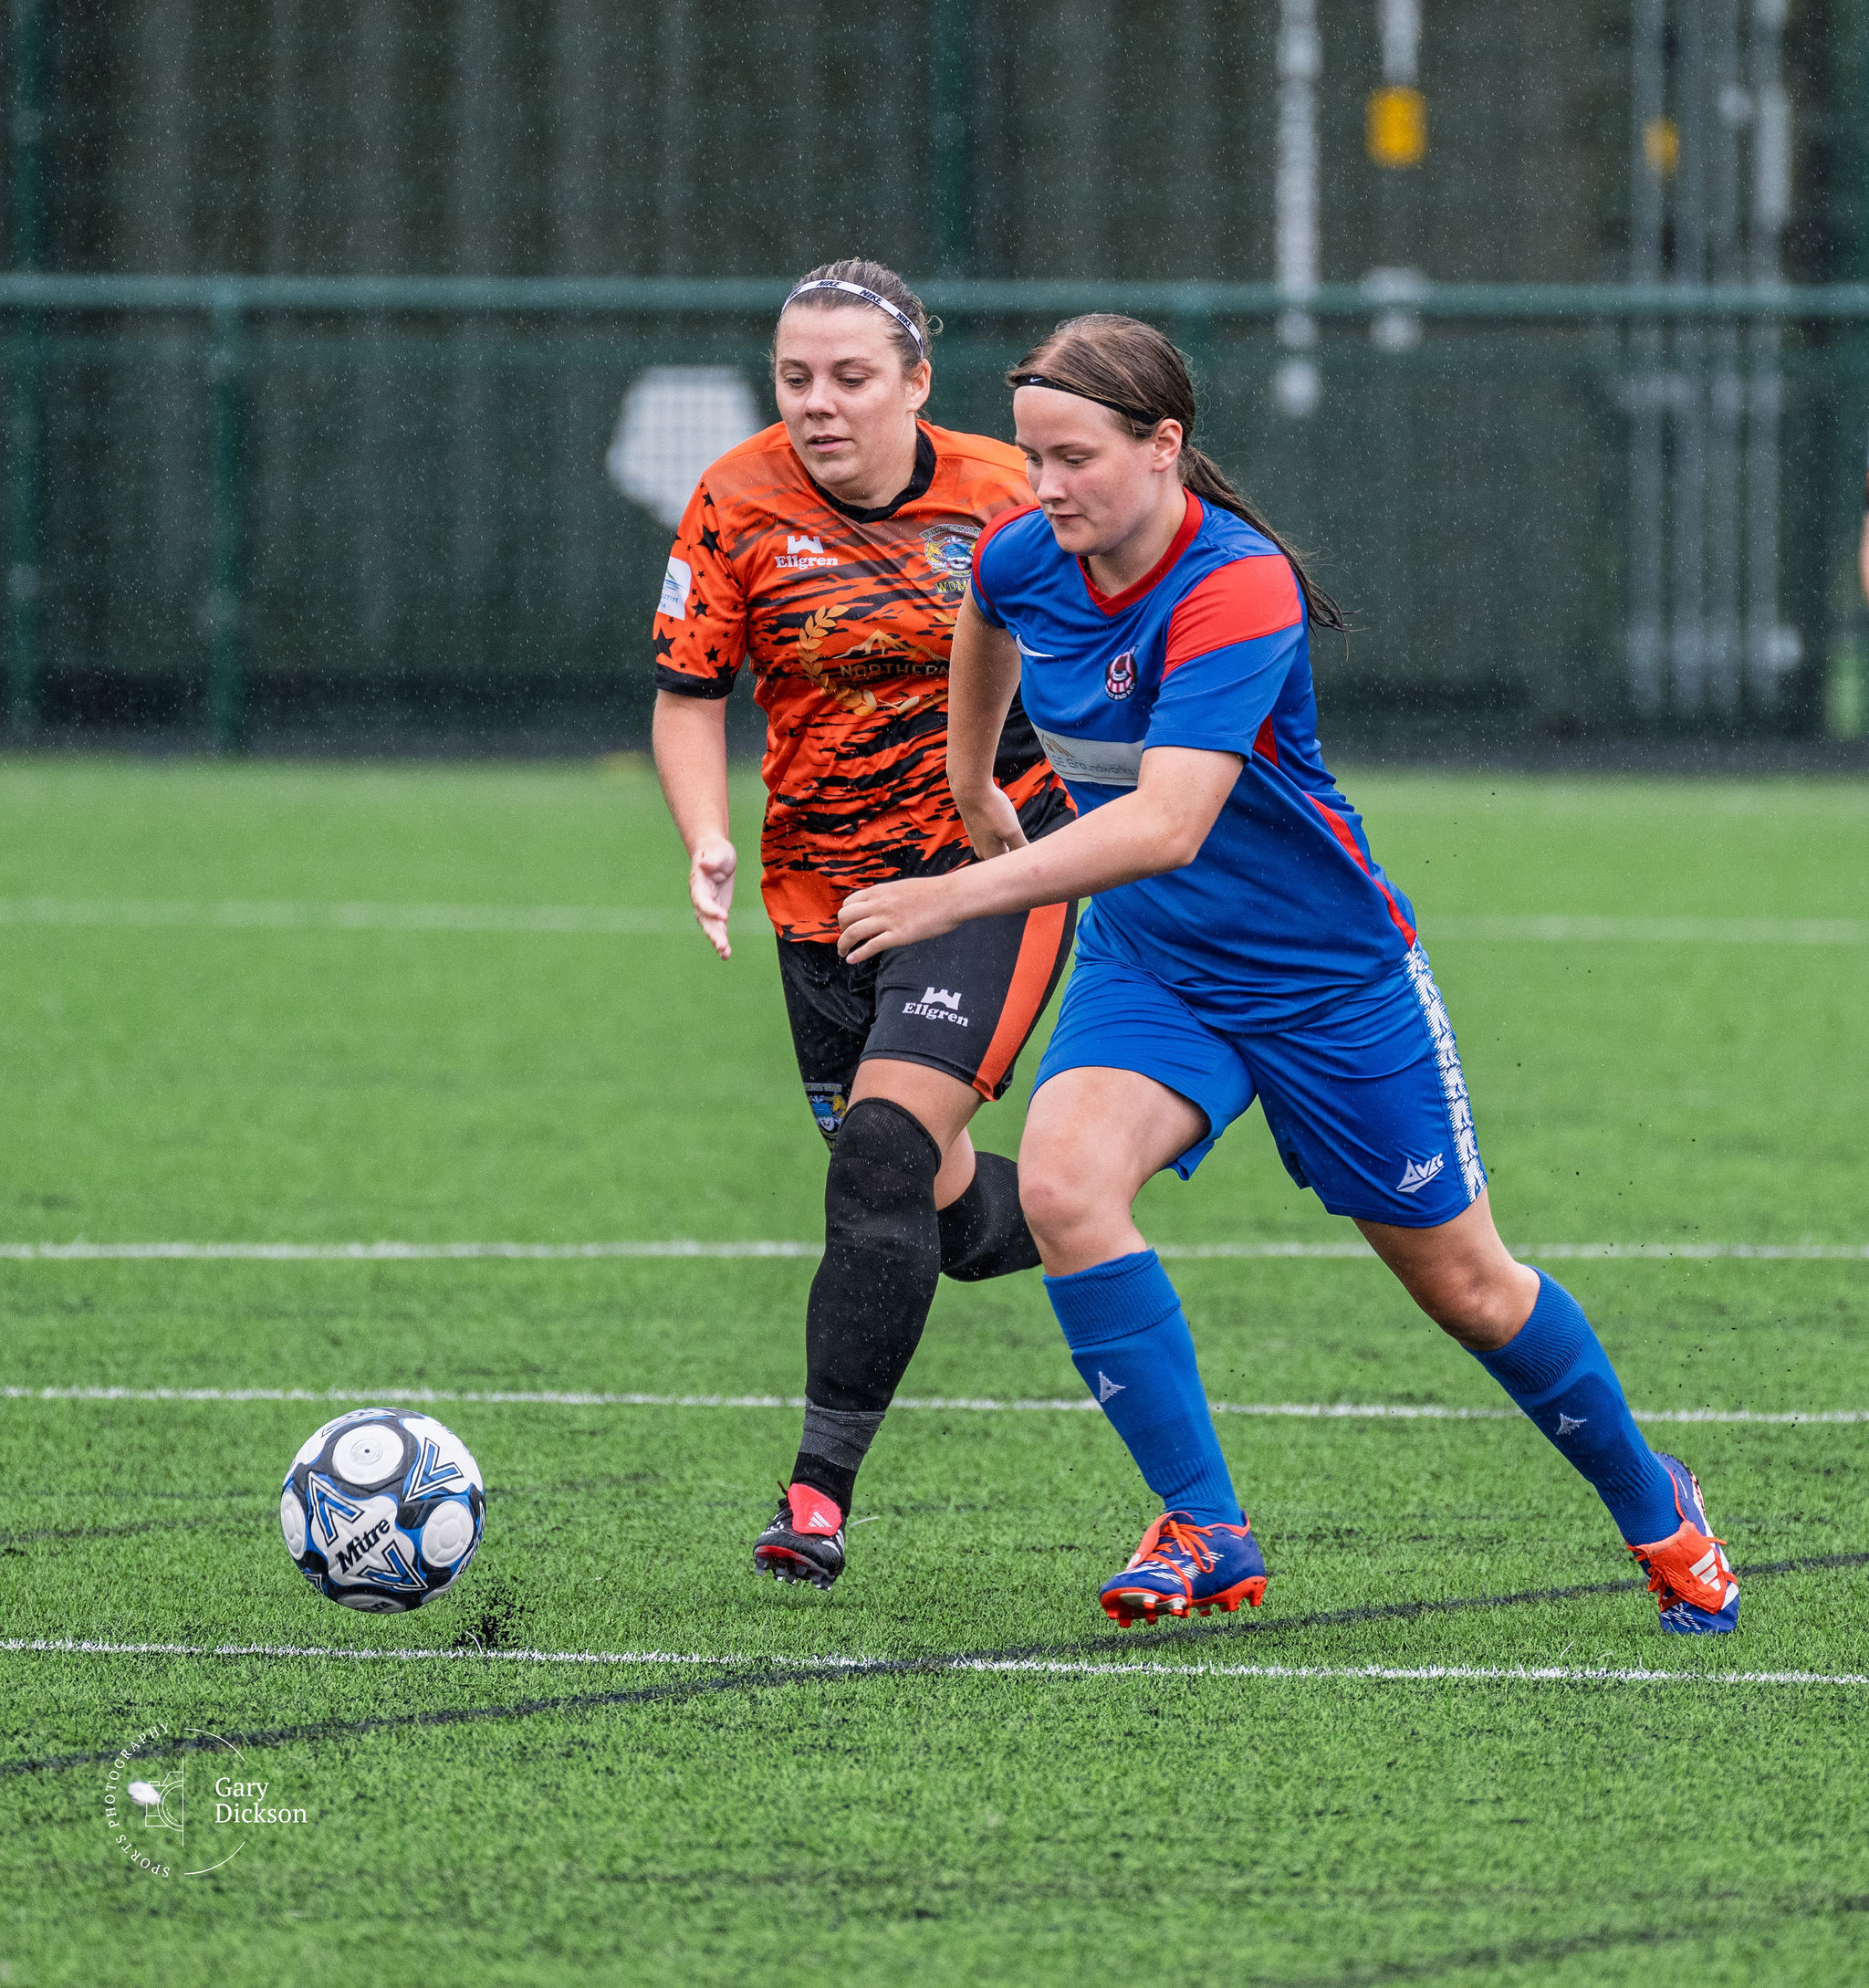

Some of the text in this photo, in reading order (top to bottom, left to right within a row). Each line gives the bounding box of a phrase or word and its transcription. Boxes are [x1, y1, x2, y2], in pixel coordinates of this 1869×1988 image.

[860, 289, 882, 305] NIKE
[896, 311, 913, 330] NIKE
[774, 555, 839, 570] Ellgren
[934, 580, 967, 593] WOM
[902, 1002, 969, 1027] Ellgren
[334, 1518, 391, 1575] Mitre
